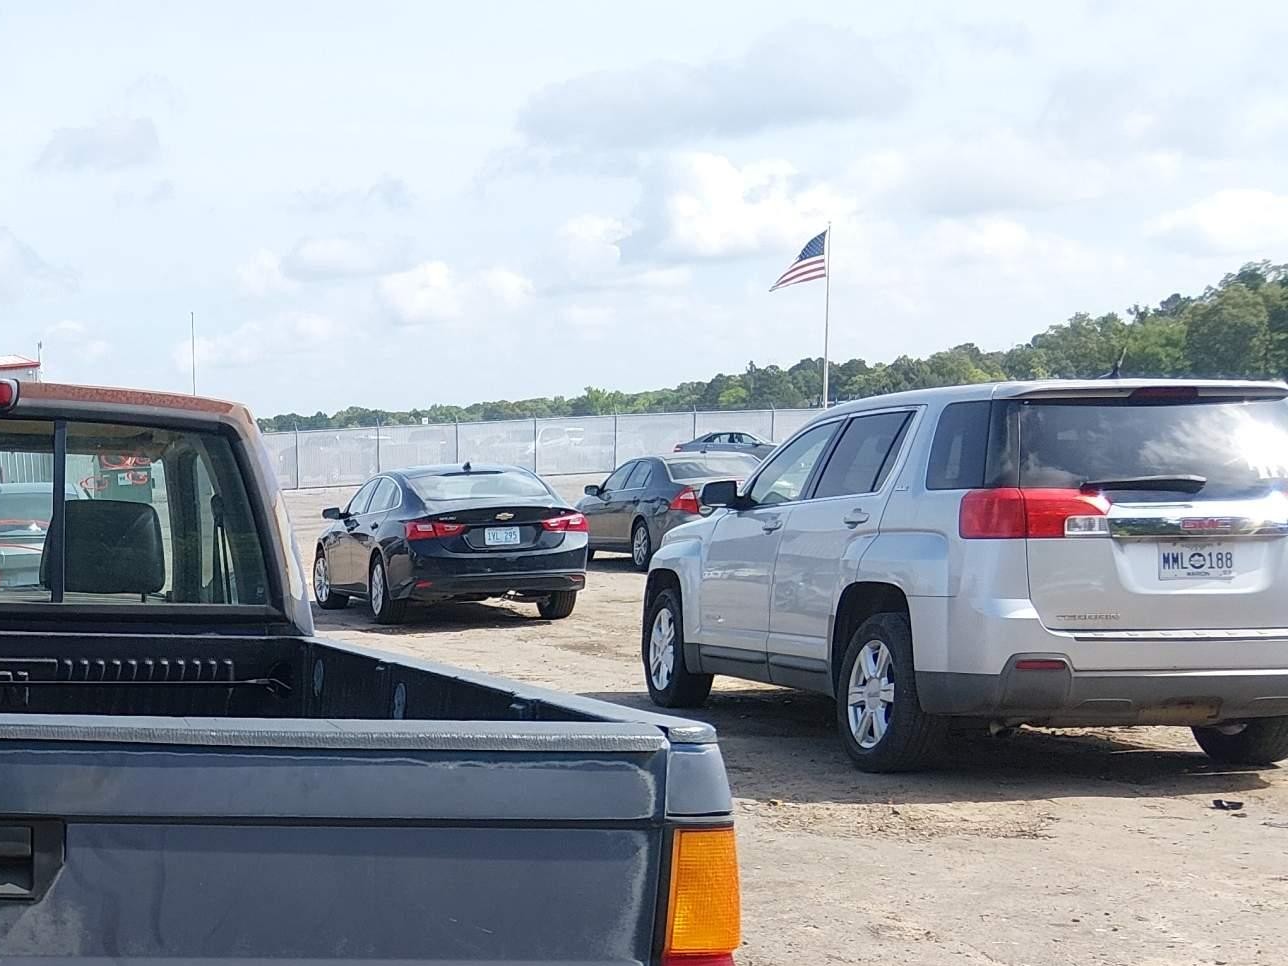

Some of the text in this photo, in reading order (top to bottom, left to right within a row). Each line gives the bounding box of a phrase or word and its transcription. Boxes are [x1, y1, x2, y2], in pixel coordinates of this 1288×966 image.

[504, 530, 518, 541] 295
[1161, 552, 1233, 569] MML 188
